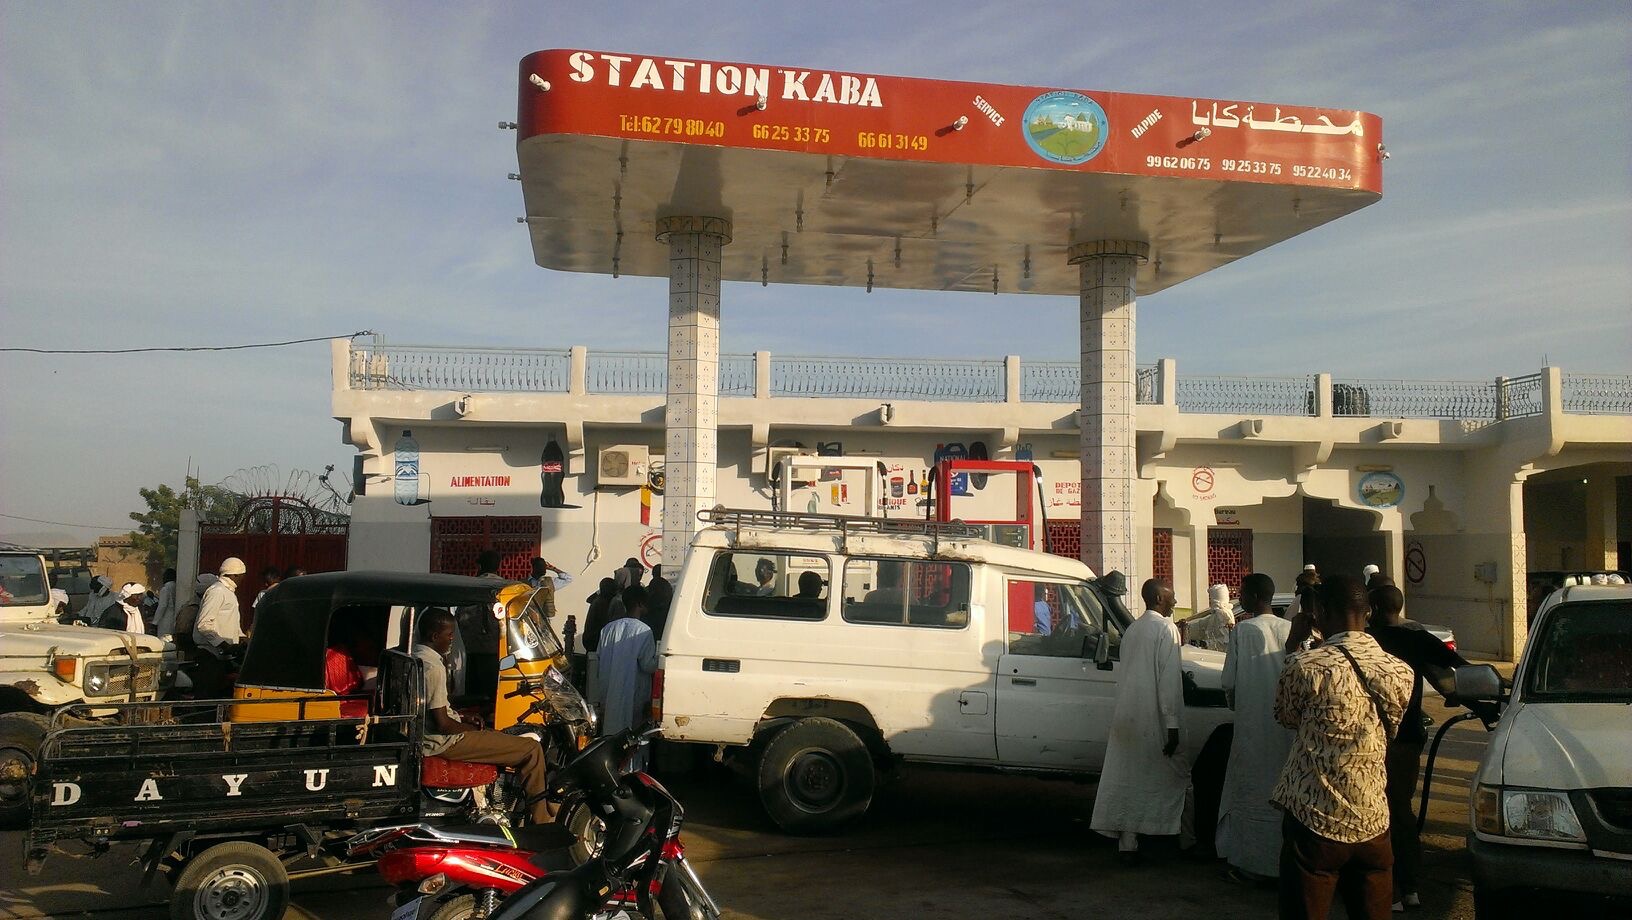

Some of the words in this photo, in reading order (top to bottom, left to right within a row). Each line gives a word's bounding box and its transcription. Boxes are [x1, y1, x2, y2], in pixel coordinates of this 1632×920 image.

[569, 52, 769, 97] STATION
[972, 95, 1005, 127] SERVICE
[1130, 109, 1163, 138] RAPIDE
[450, 475, 511, 487] ALIMENTATION
[50, 764, 399, 807] DAYUN
